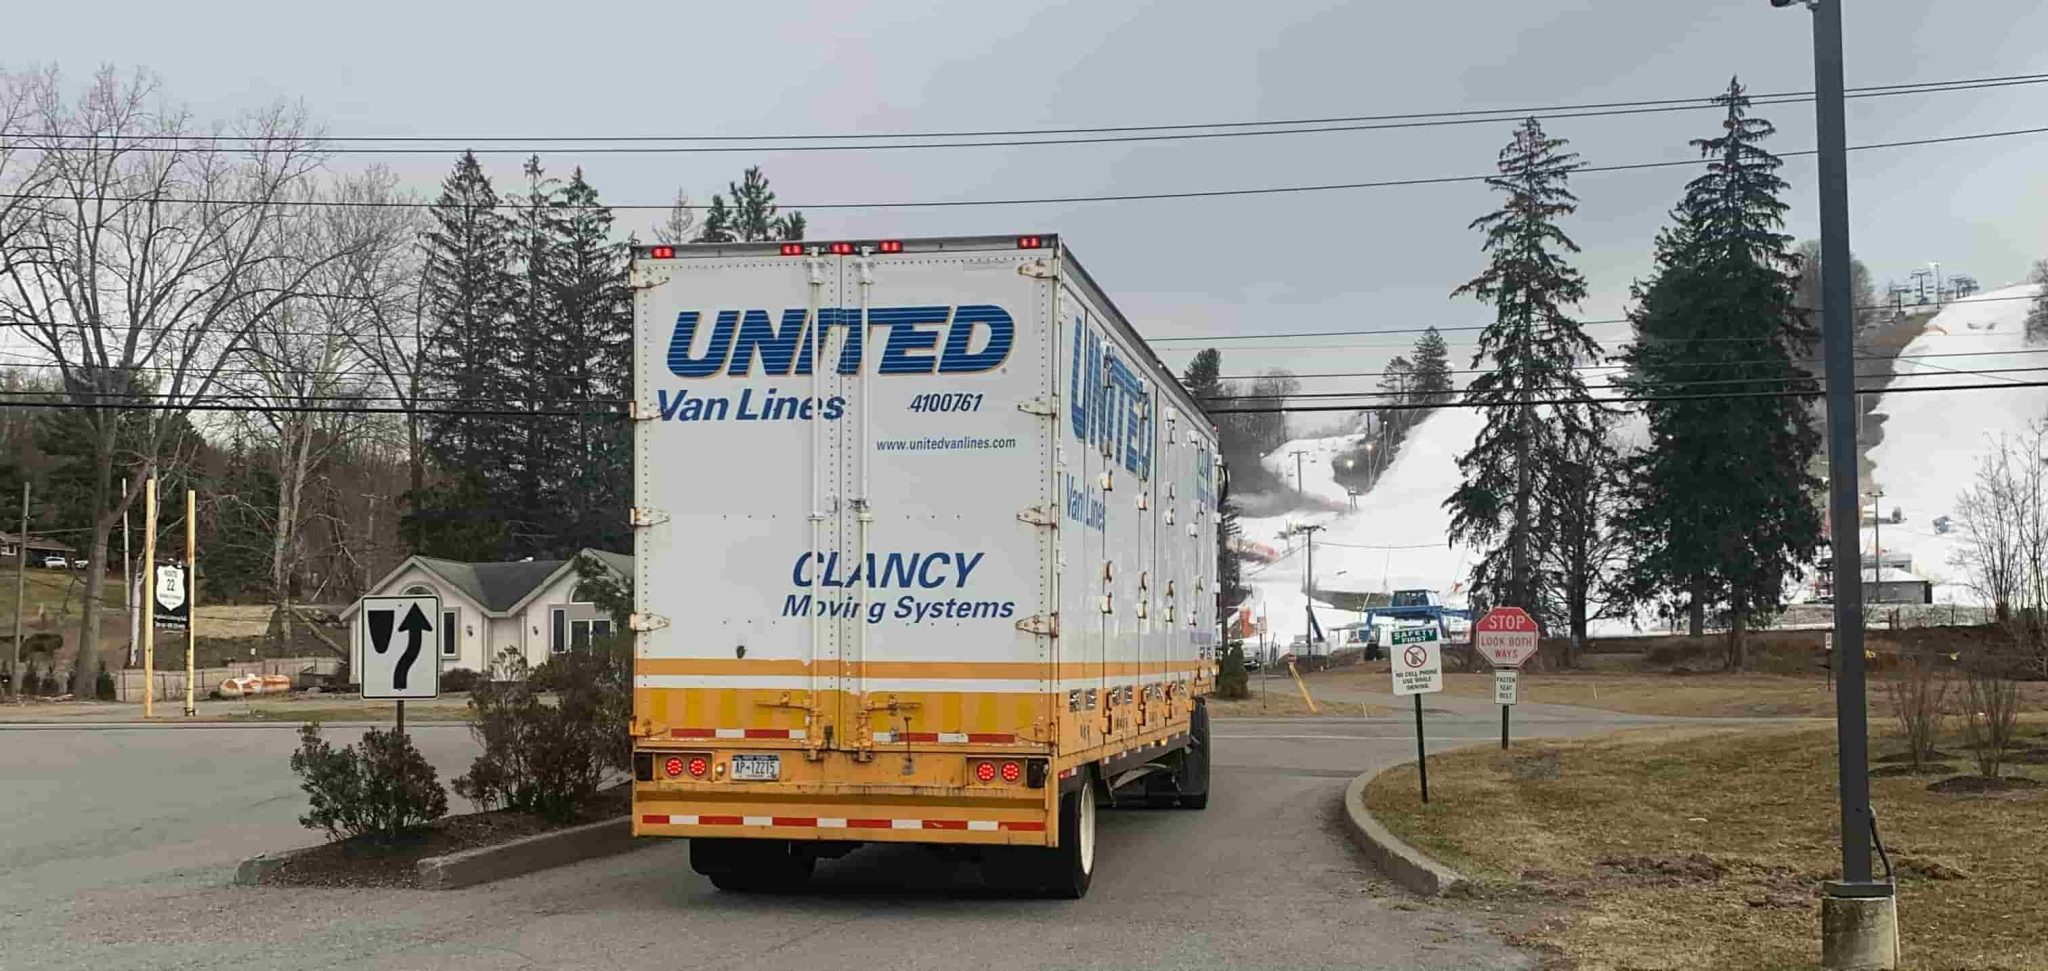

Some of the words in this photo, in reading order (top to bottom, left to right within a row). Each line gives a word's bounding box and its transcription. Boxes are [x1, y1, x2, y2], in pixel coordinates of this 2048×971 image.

[667, 304, 1016, 379] UNITED
[658, 389, 729, 421] Van
[735, 388, 846, 421] Lines
[910, 393, 983, 413] 4100761
[876, 436, 1017, 451] www.unitedvanlines.com
[792, 551, 985, 588] CLANCY
[167, 578, 175, 592] 22
[782, 594, 886, 624] Moving
[894, 596, 1016, 624] Systems
[1489, 615, 1526, 630] STOP
[1393, 629, 1436, 640] SAFETY
[1481, 637, 1505, 647] LOOK
[1509, 637, 1533, 647] BOTH
[1495, 649, 1518, 659] WAYS
